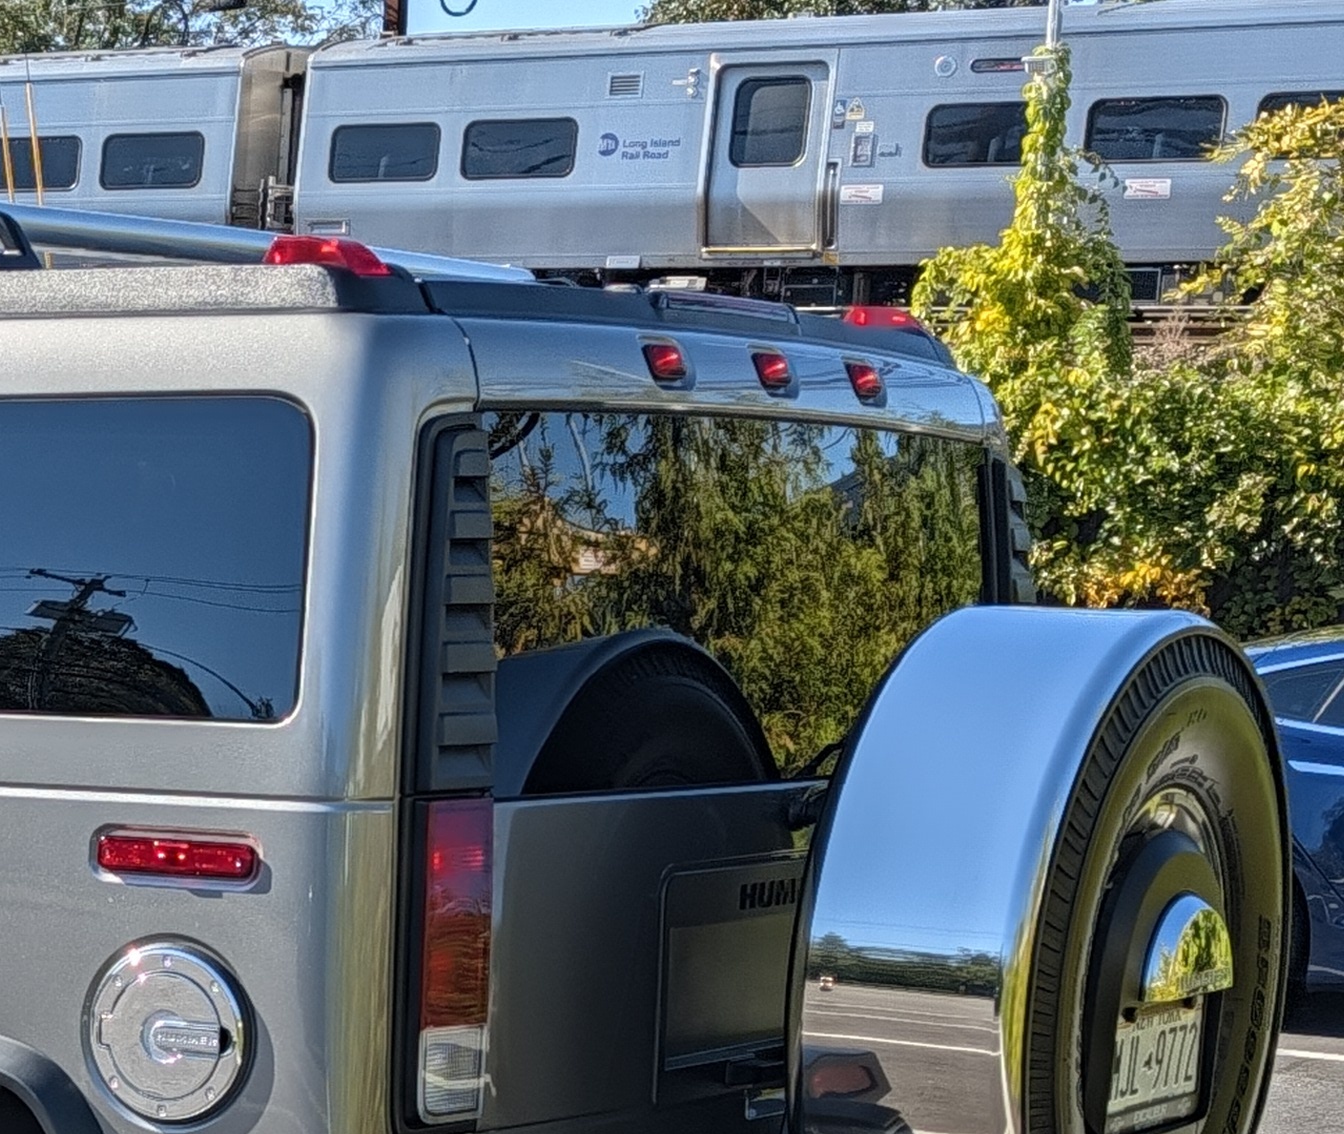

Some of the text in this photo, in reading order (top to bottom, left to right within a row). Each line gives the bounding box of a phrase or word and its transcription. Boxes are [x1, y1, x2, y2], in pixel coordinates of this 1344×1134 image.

[622, 137, 682, 150] Long Island
[621, 149, 670, 160] Rail Road
[739, 878, 797, 910] HUM
